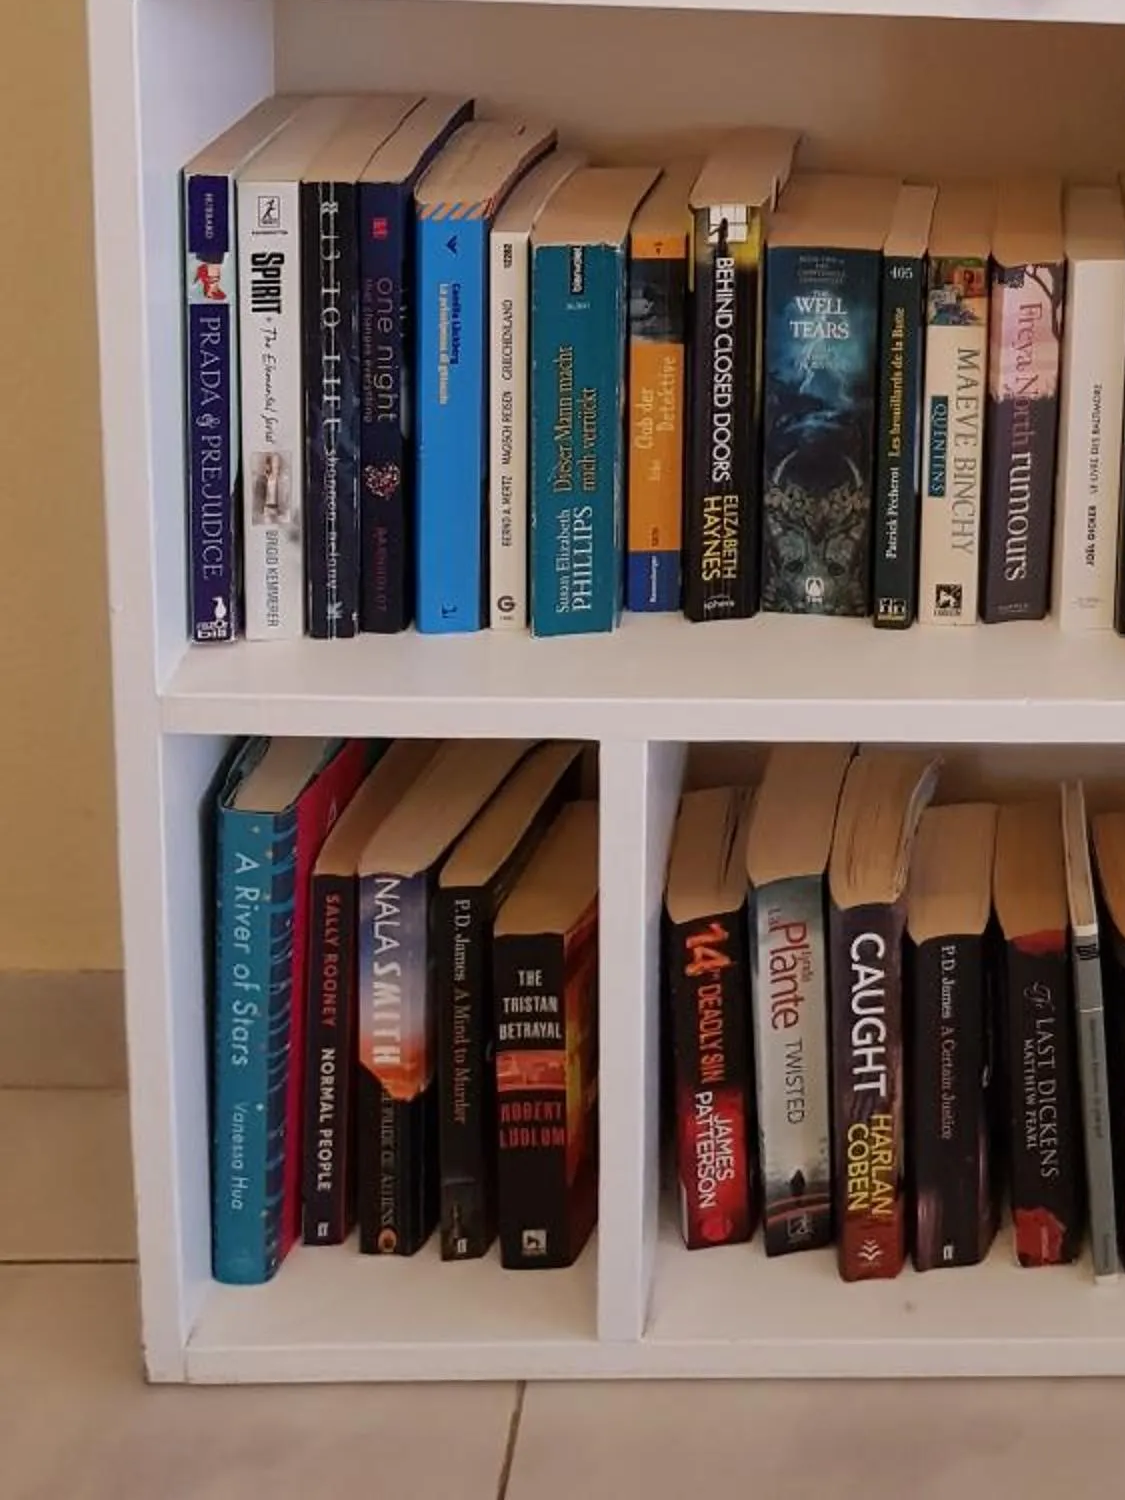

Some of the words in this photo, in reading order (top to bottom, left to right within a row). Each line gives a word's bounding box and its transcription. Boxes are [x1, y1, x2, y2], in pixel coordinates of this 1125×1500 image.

[251, 252, 285, 315] SPIRIT
[376, 277, 394, 334] one
[714, 257, 736, 328] BEHIND
[794, 297, 847, 317] WELL
[199, 316, 222, 407] PRADA
[789, 320, 850, 341] TEARS
[1010, 303, 1042, 371] Freya
[373, 346, 399, 422] night
[712, 333, 734, 407] CLOSED
[953, 347, 981, 447] MAEVE
[195, 413, 222, 429] &
[1012, 374, 1040, 447] North
[712, 413, 732, 483] DOORS
[199, 435, 223, 579] PREJUDICE
[886, 466, 900, 517] Pécherot
[951, 455, 978, 556] BINCHY
[1005, 451, 1032, 581] rumours
[555, 508, 571, 573] Elizabeth
[573, 506, 593, 611] PHILLIPS
[702, 494, 721, 581] HAYNES
[722, 494, 740, 579] ELIZABETH
[885, 519, 899, 559] Patrick
[555, 575, 571, 613] Susan
[235, 852, 259, 874] A
[234, 884, 259, 954] River
[323, 894, 341, 946] SALLY
[374, 878, 401, 955] NALA
[231, 962, 260, 992] of
[321, 953, 339, 1027] ROONEY
[502, 995, 560, 1013] TRISTAN
[518, 968, 543, 987] THE
[767, 920, 810, 1031] Plante
[231, 1000, 258, 1067] Stars
[372, 960, 402, 1066] SMITH
[499, 1021, 562, 1041] BETRAYAL
[697, 984, 724, 1050] DEADLY
[849, 932, 887, 1097] CAUGHT
[1035, 1017, 1057, 1070] LAST
[319, 1048, 336, 1123] NORMAL
[700, 1052, 725, 1084] SIN
[784, 1037, 807, 1125] TWISTED
[1023, 1038, 1038, 1106] MATTHEW
[231, 1101, 249, 1169] Vanessa
[317, 1128, 334, 1191] PEOPLE
[695, 1091, 716, 1209] PATTERSON
[714, 1114, 735, 1182] JAMES
[1025, 1110, 1038, 1151] PEARL
[1037, 1079, 1060, 1179] DICKENS
[231, 1175, 248, 1210] Hua
[846, 1122, 870, 1212] COBEN
[869, 1113, 894, 1215] HARLAN
